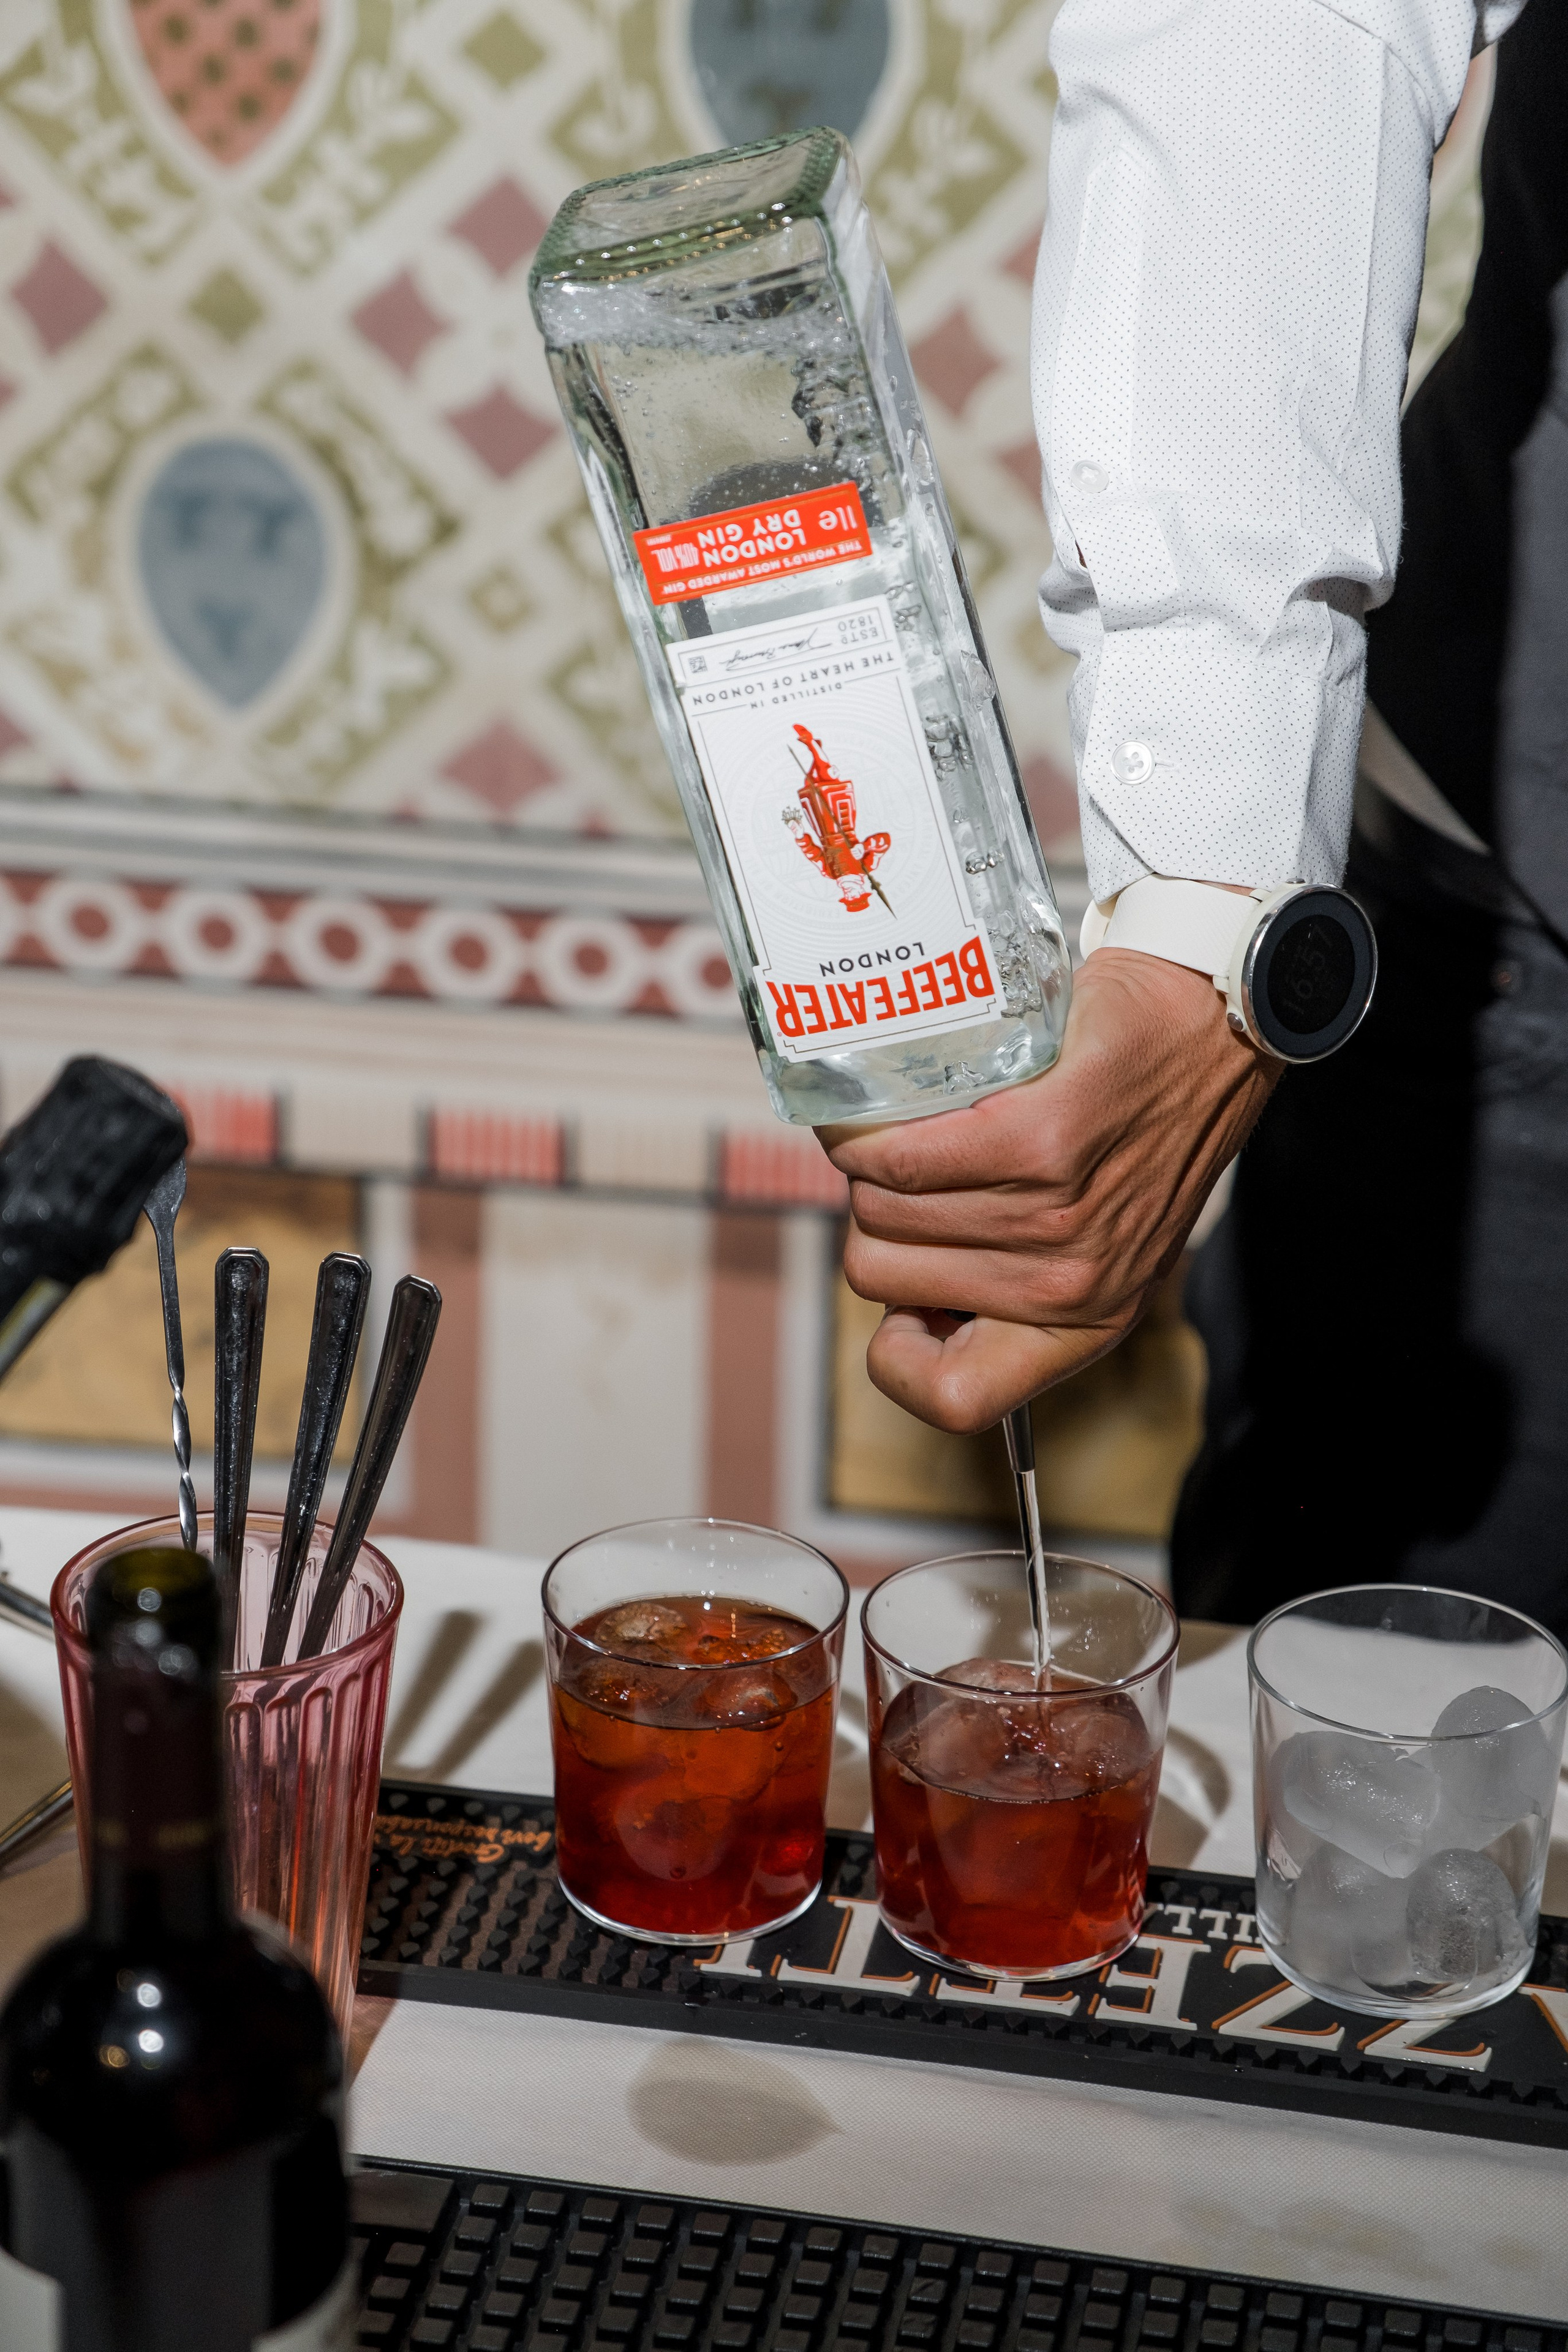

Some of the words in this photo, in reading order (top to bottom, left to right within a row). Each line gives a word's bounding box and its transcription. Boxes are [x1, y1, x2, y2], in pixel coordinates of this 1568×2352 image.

[753, 509, 802, 536] DRY
[697, 524, 744, 549] GIN
[839, 540, 862, 554] THE
[702, 528, 806, 567] LONDON
[783, 547, 836, 567] WORLD'S
[748, 559, 780, 576] MOST
[689, 568, 745, 589] AWARDED
[837, 614, 874, 632] 1820
[861, 651, 894, 668] THE
[799, 658, 854, 683] HEART
[771, 676, 791, 689] OF
[771, 682, 842, 704] DISTILLED
[692, 682, 763, 706] LONDON
[750, 700, 764, 709] IN
[818, 942, 924, 977] LONDON
[766, 936, 995, 1038] BEEFEATER
